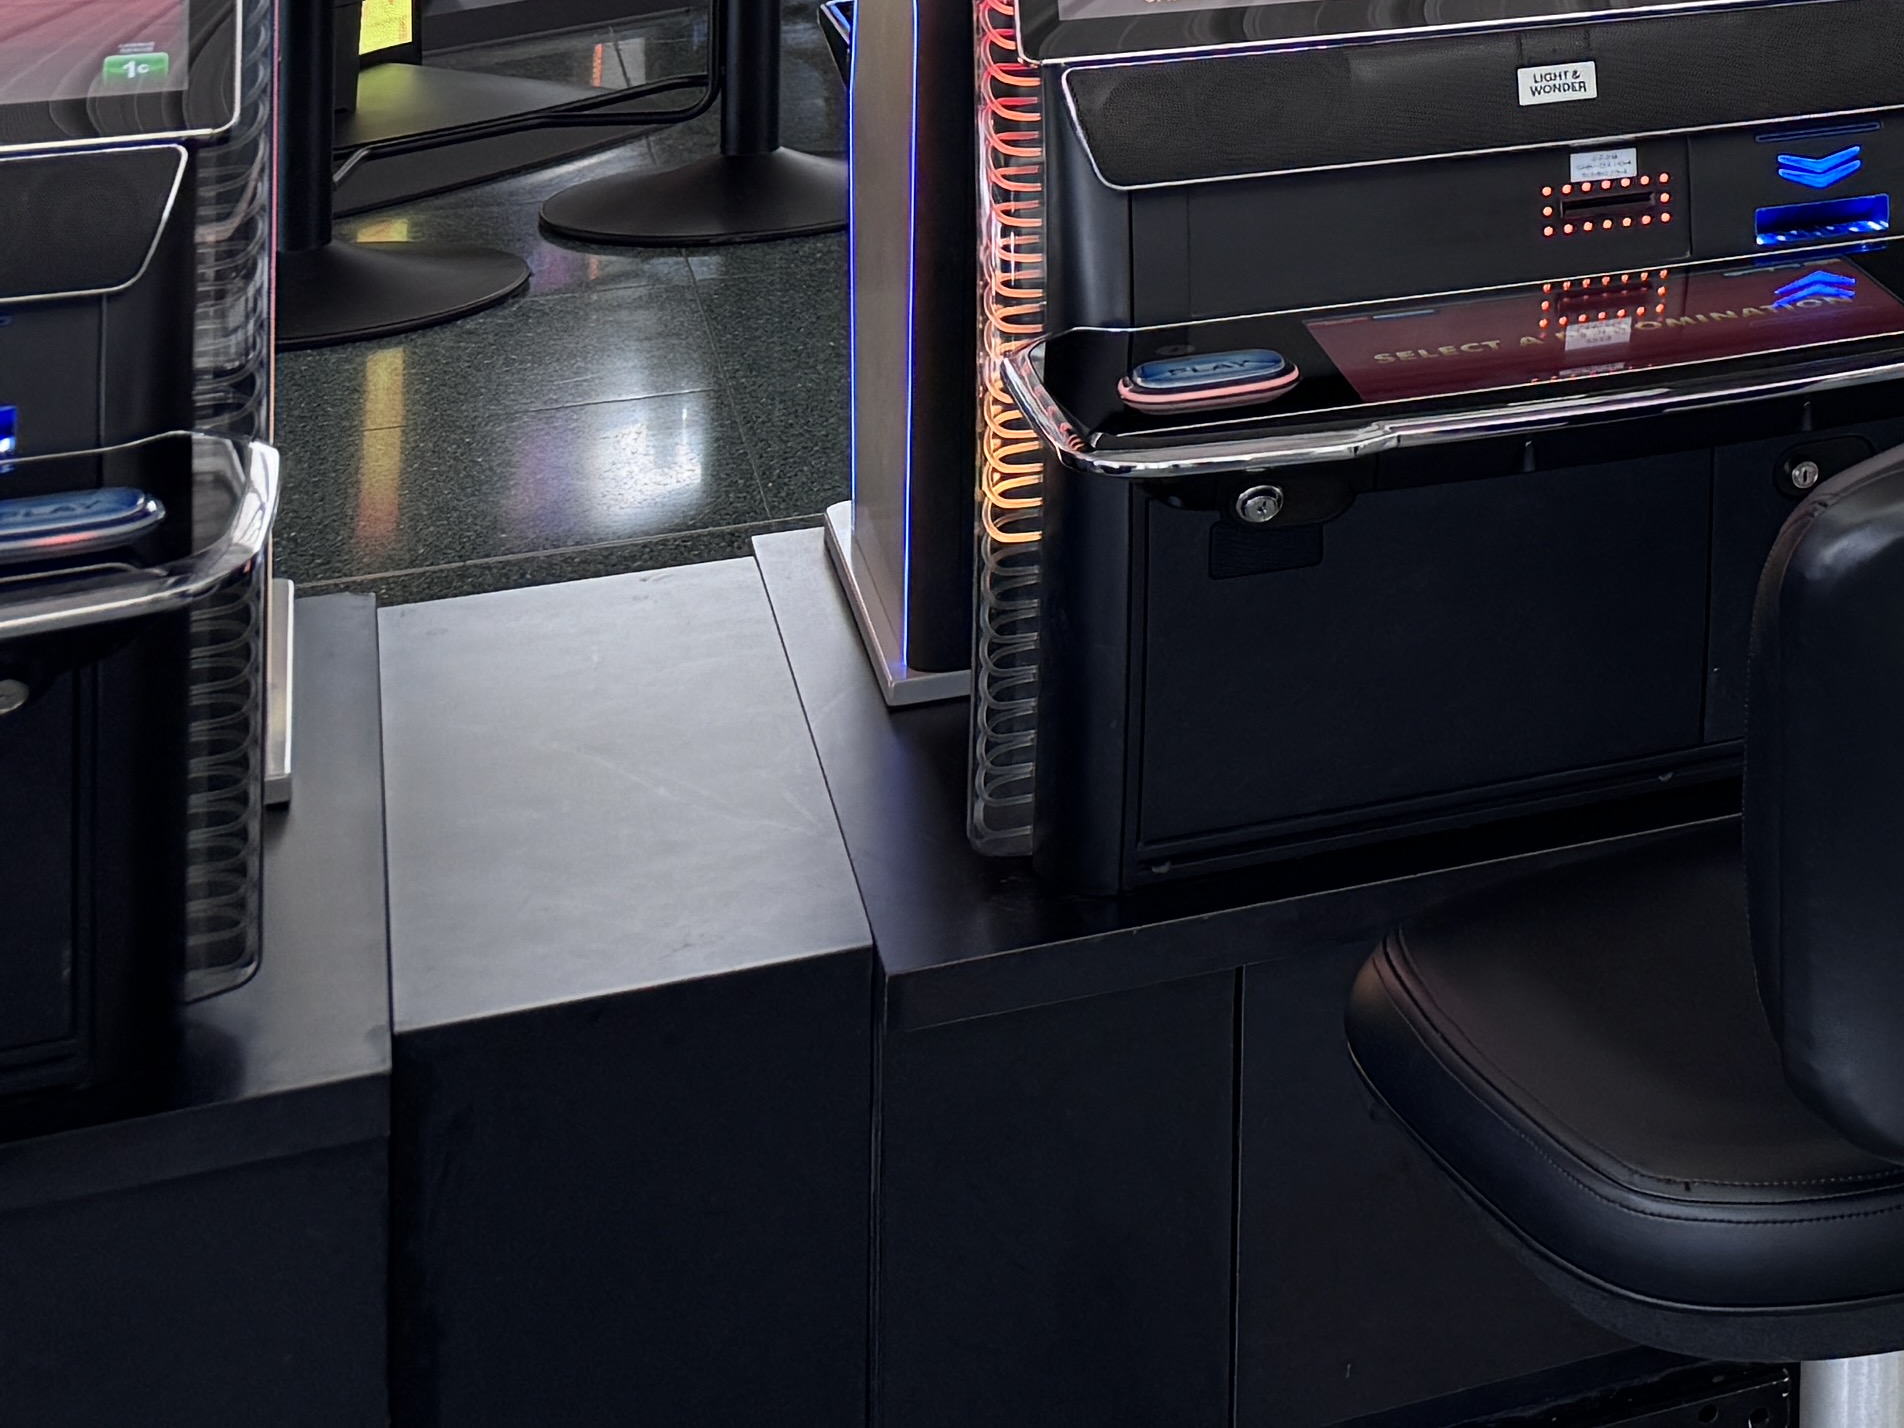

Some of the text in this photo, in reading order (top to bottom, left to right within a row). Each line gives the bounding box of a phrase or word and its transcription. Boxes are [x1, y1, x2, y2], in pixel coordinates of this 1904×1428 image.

[1533, 70, 1569, 84] LIGHT
[1530, 81, 1587, 97] WONDER
[1374, 339, 1501, 364] SELECT
[1168, 359, 1251, 376] PLAY
